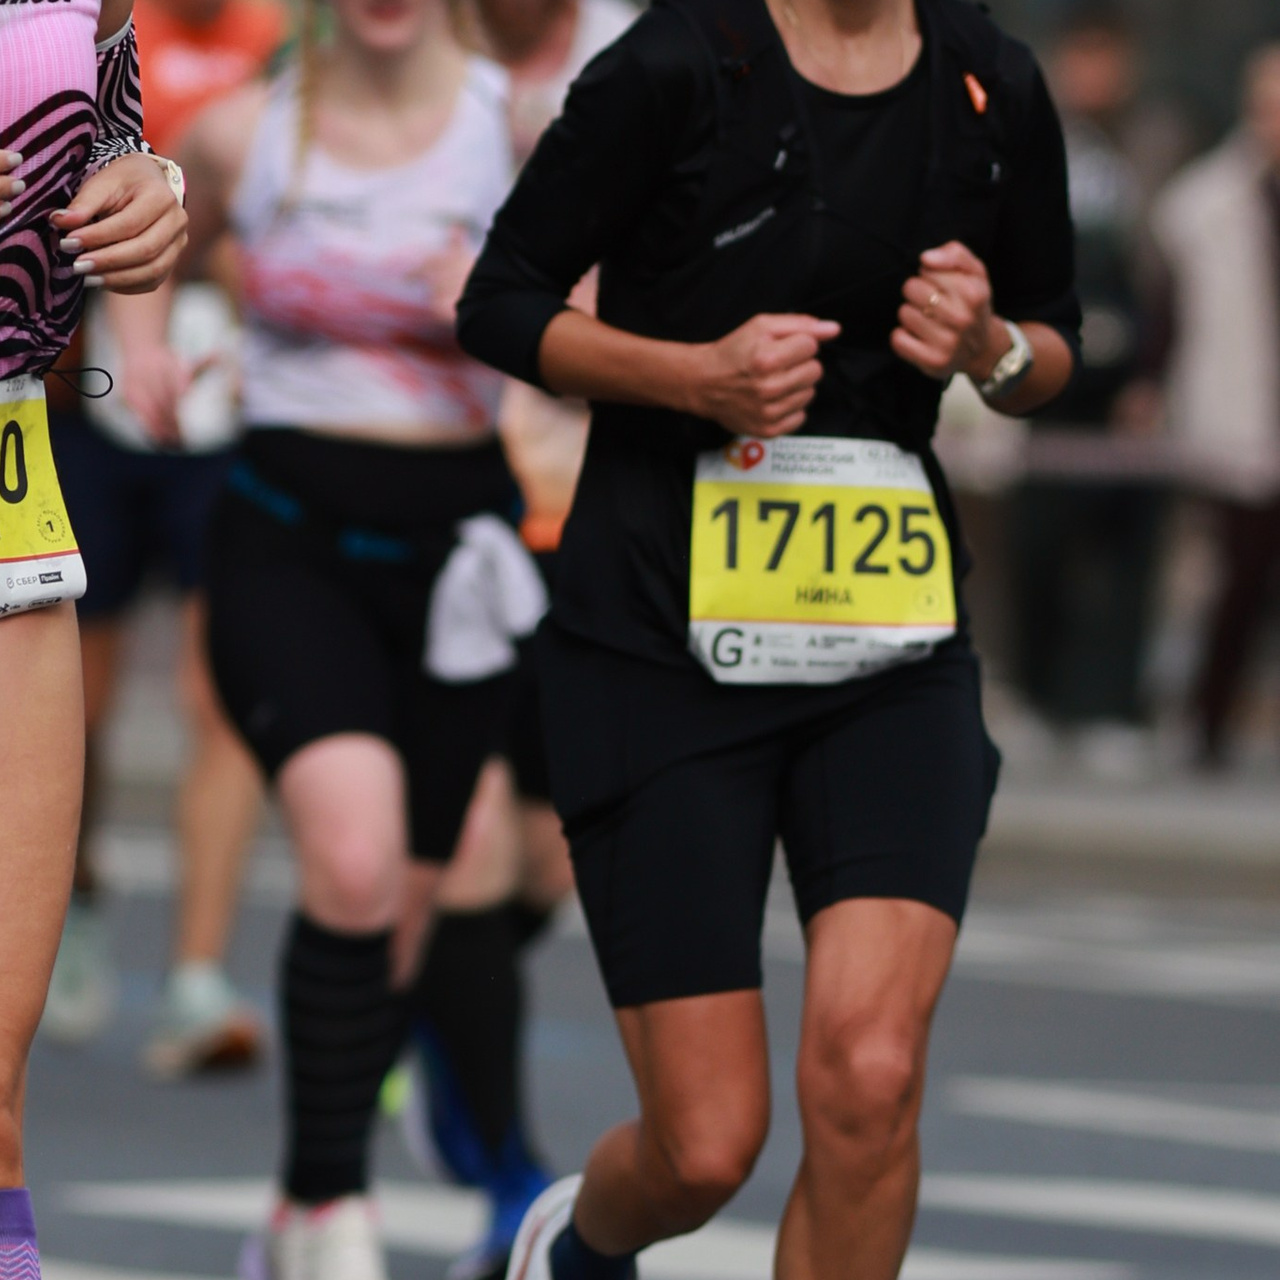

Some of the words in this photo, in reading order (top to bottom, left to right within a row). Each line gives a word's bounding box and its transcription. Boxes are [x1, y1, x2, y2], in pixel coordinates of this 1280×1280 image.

[45, 520, 55, 533] 1
[710, 497, 936, 578] 17125
[16, 576, 37, 587] СБЕР
[794, 586, 853, 606] НИНА
[711, 627, 744, 668] G
